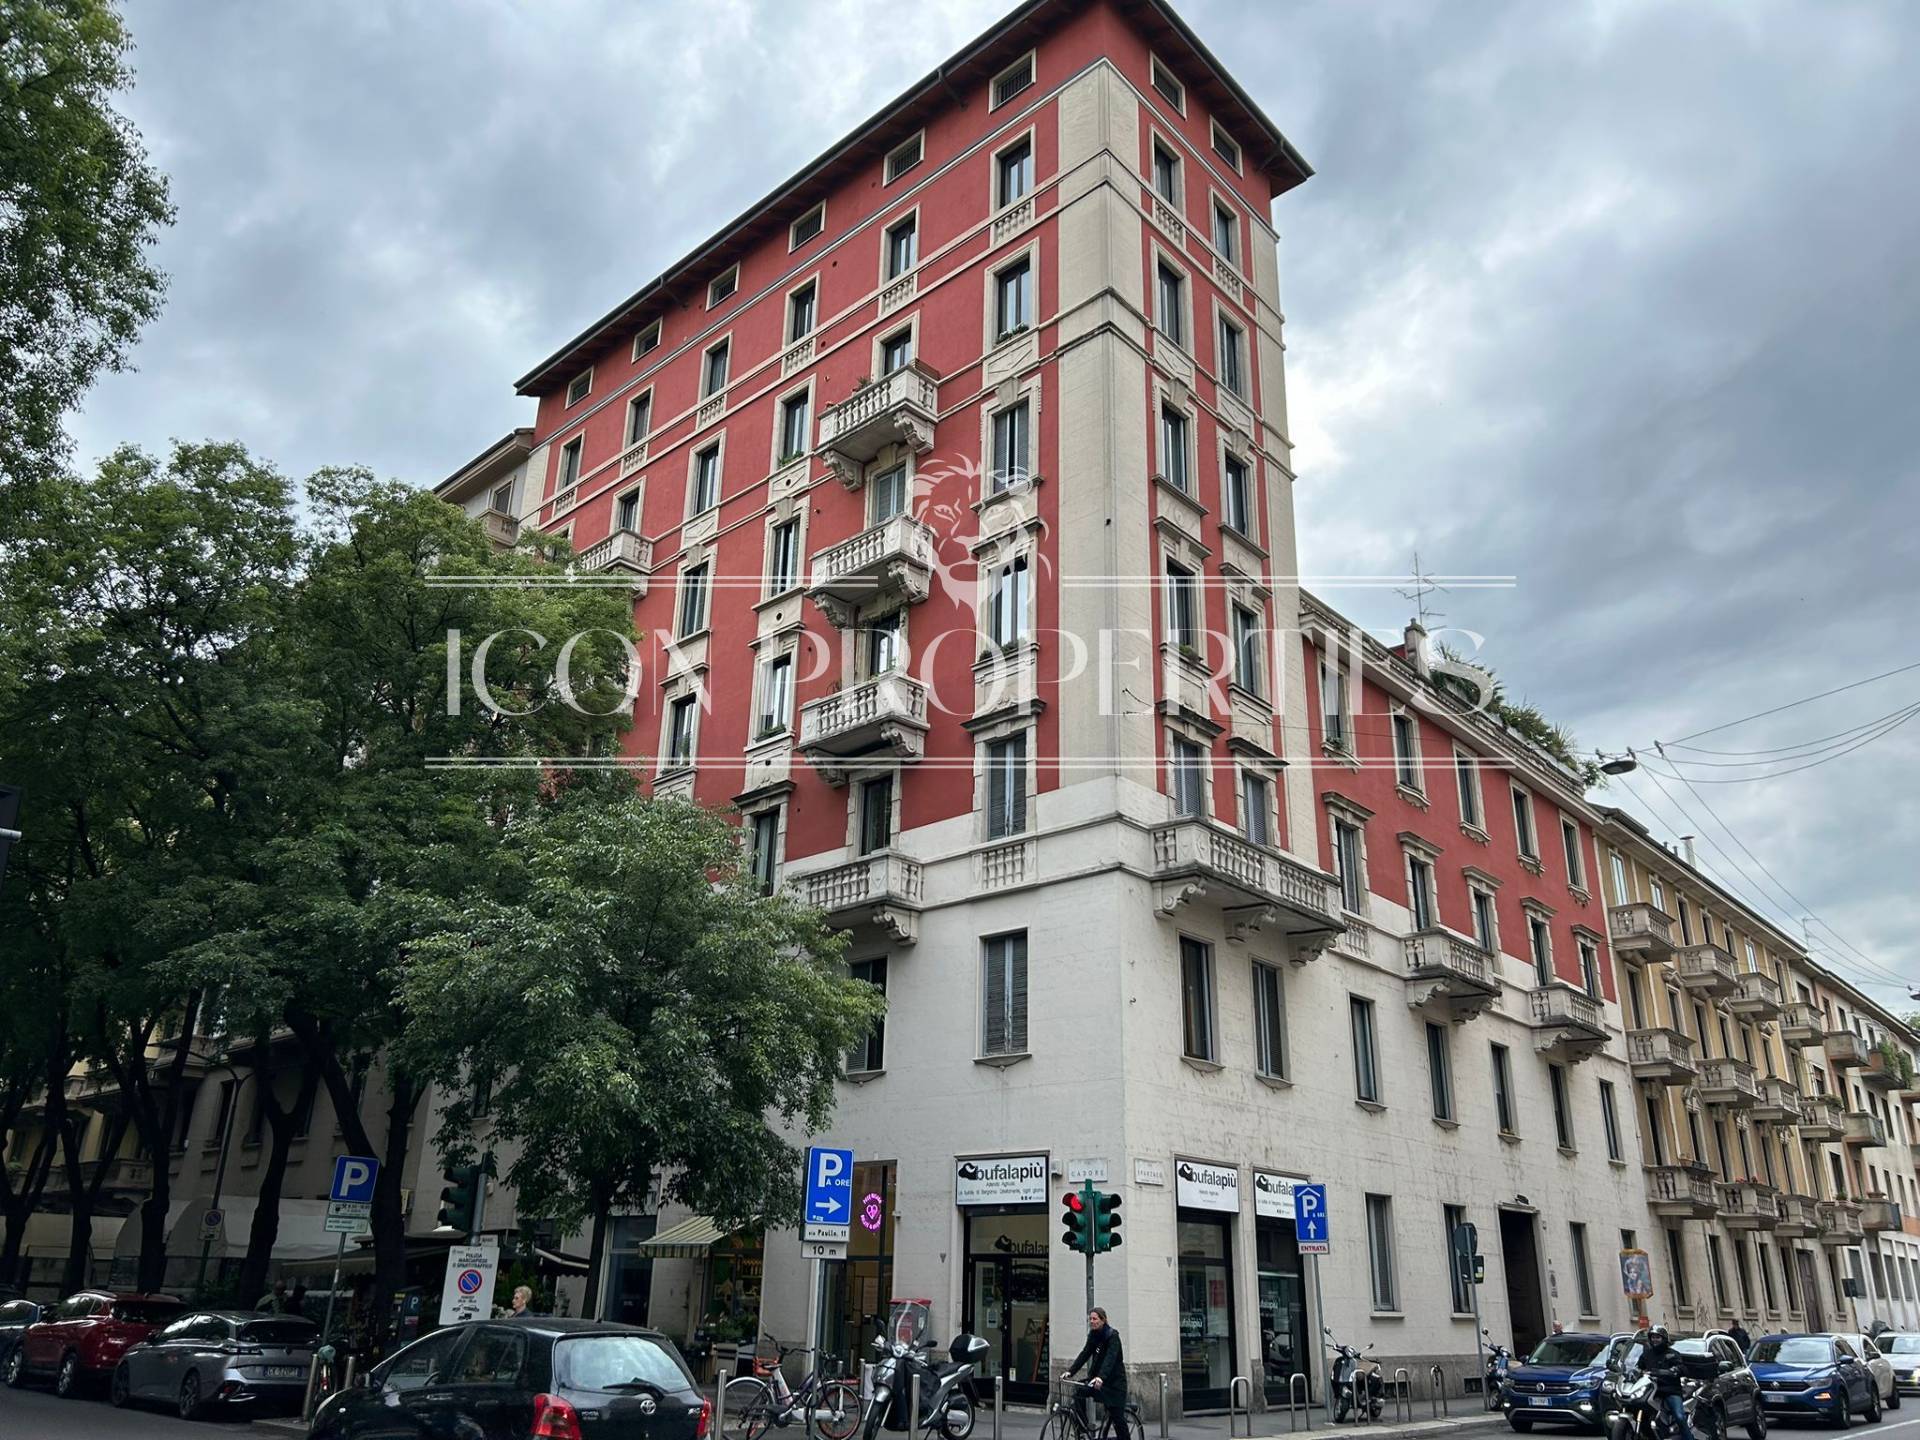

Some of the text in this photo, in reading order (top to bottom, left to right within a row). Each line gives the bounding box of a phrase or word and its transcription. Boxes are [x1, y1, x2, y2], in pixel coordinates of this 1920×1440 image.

[339, 1161, 369, 1197] P
[818, 1153, 843, 1188] P
[835, 1179, 850, 1187] ORE
[1302, 1195, 1318, 1218] P
[812, 1246, 824, 1255] 10
